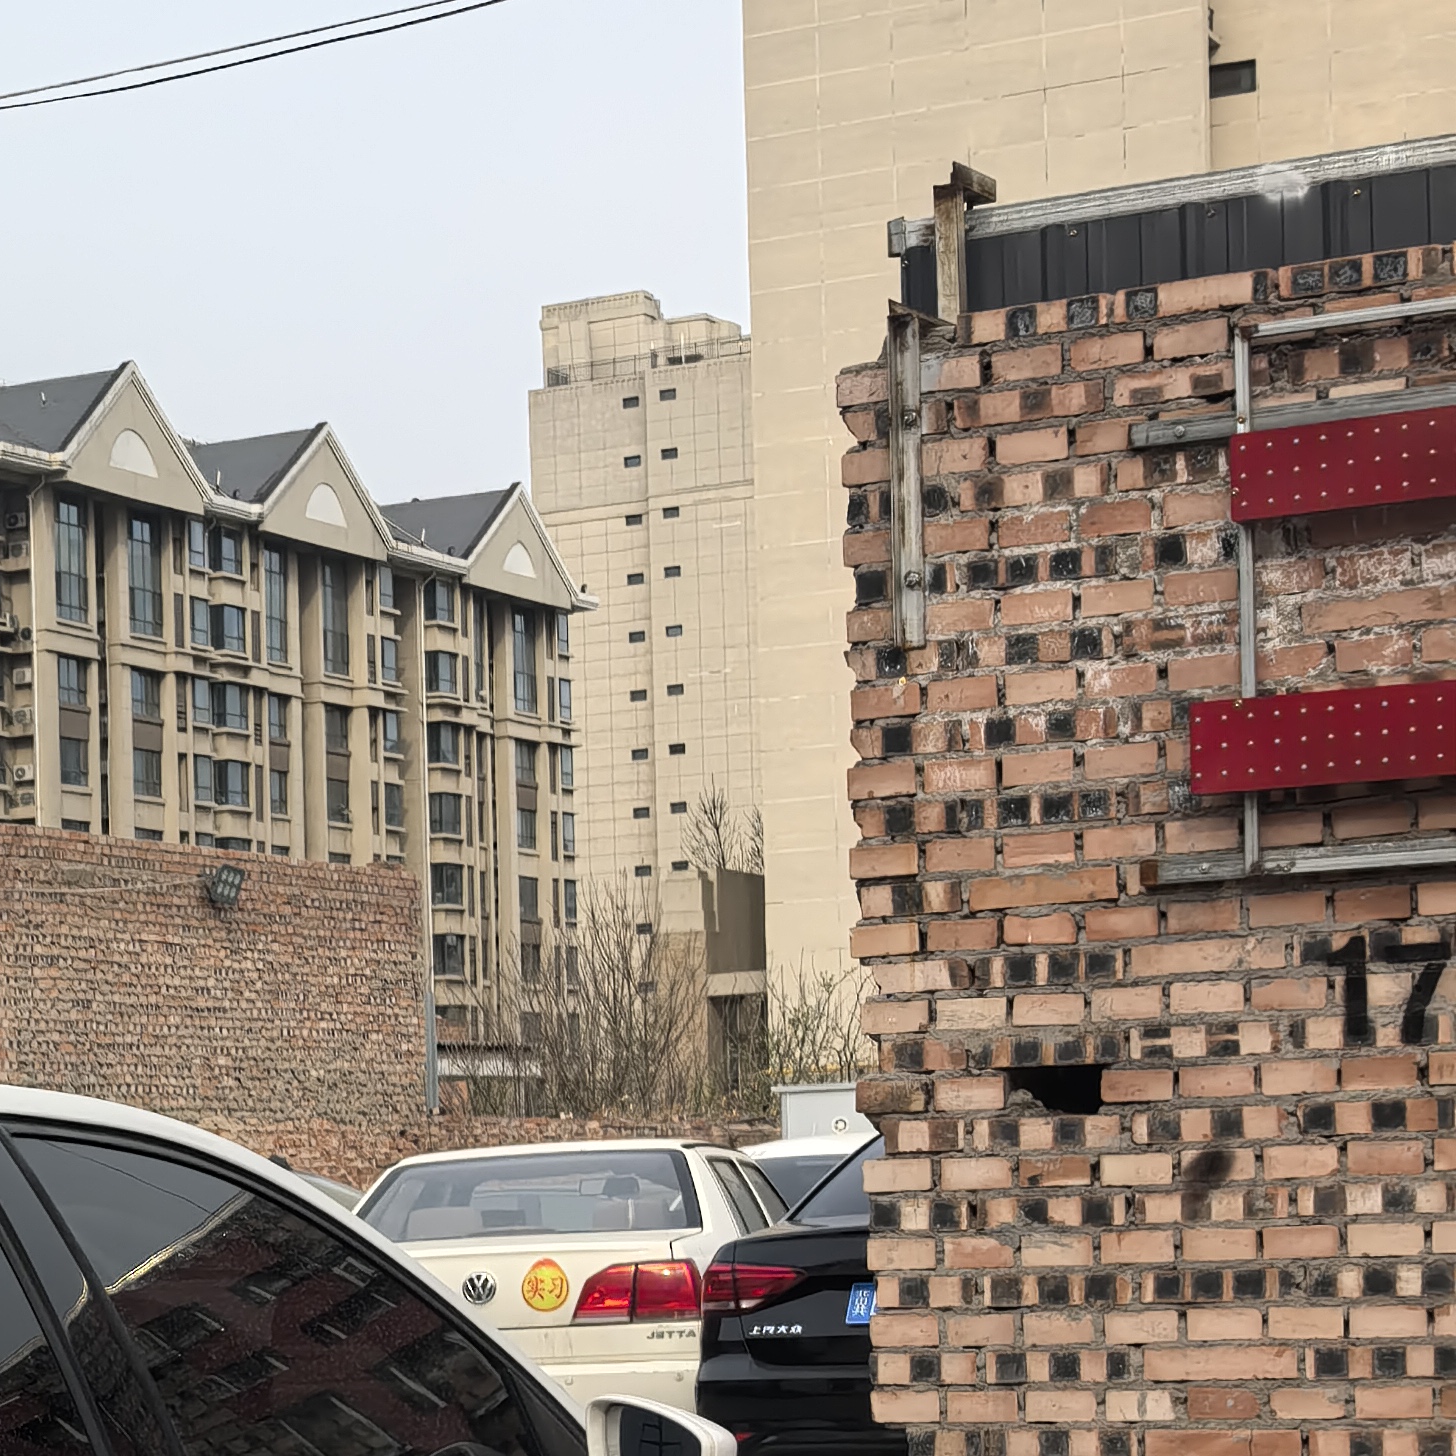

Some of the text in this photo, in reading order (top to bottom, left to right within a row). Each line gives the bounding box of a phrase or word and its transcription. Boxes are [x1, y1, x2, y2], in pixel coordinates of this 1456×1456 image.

[1326, 935, 1452, 1044] 17
[525, 1275, 564, 1301] 实习
[646, 1328, 697, 1340] JETTA
